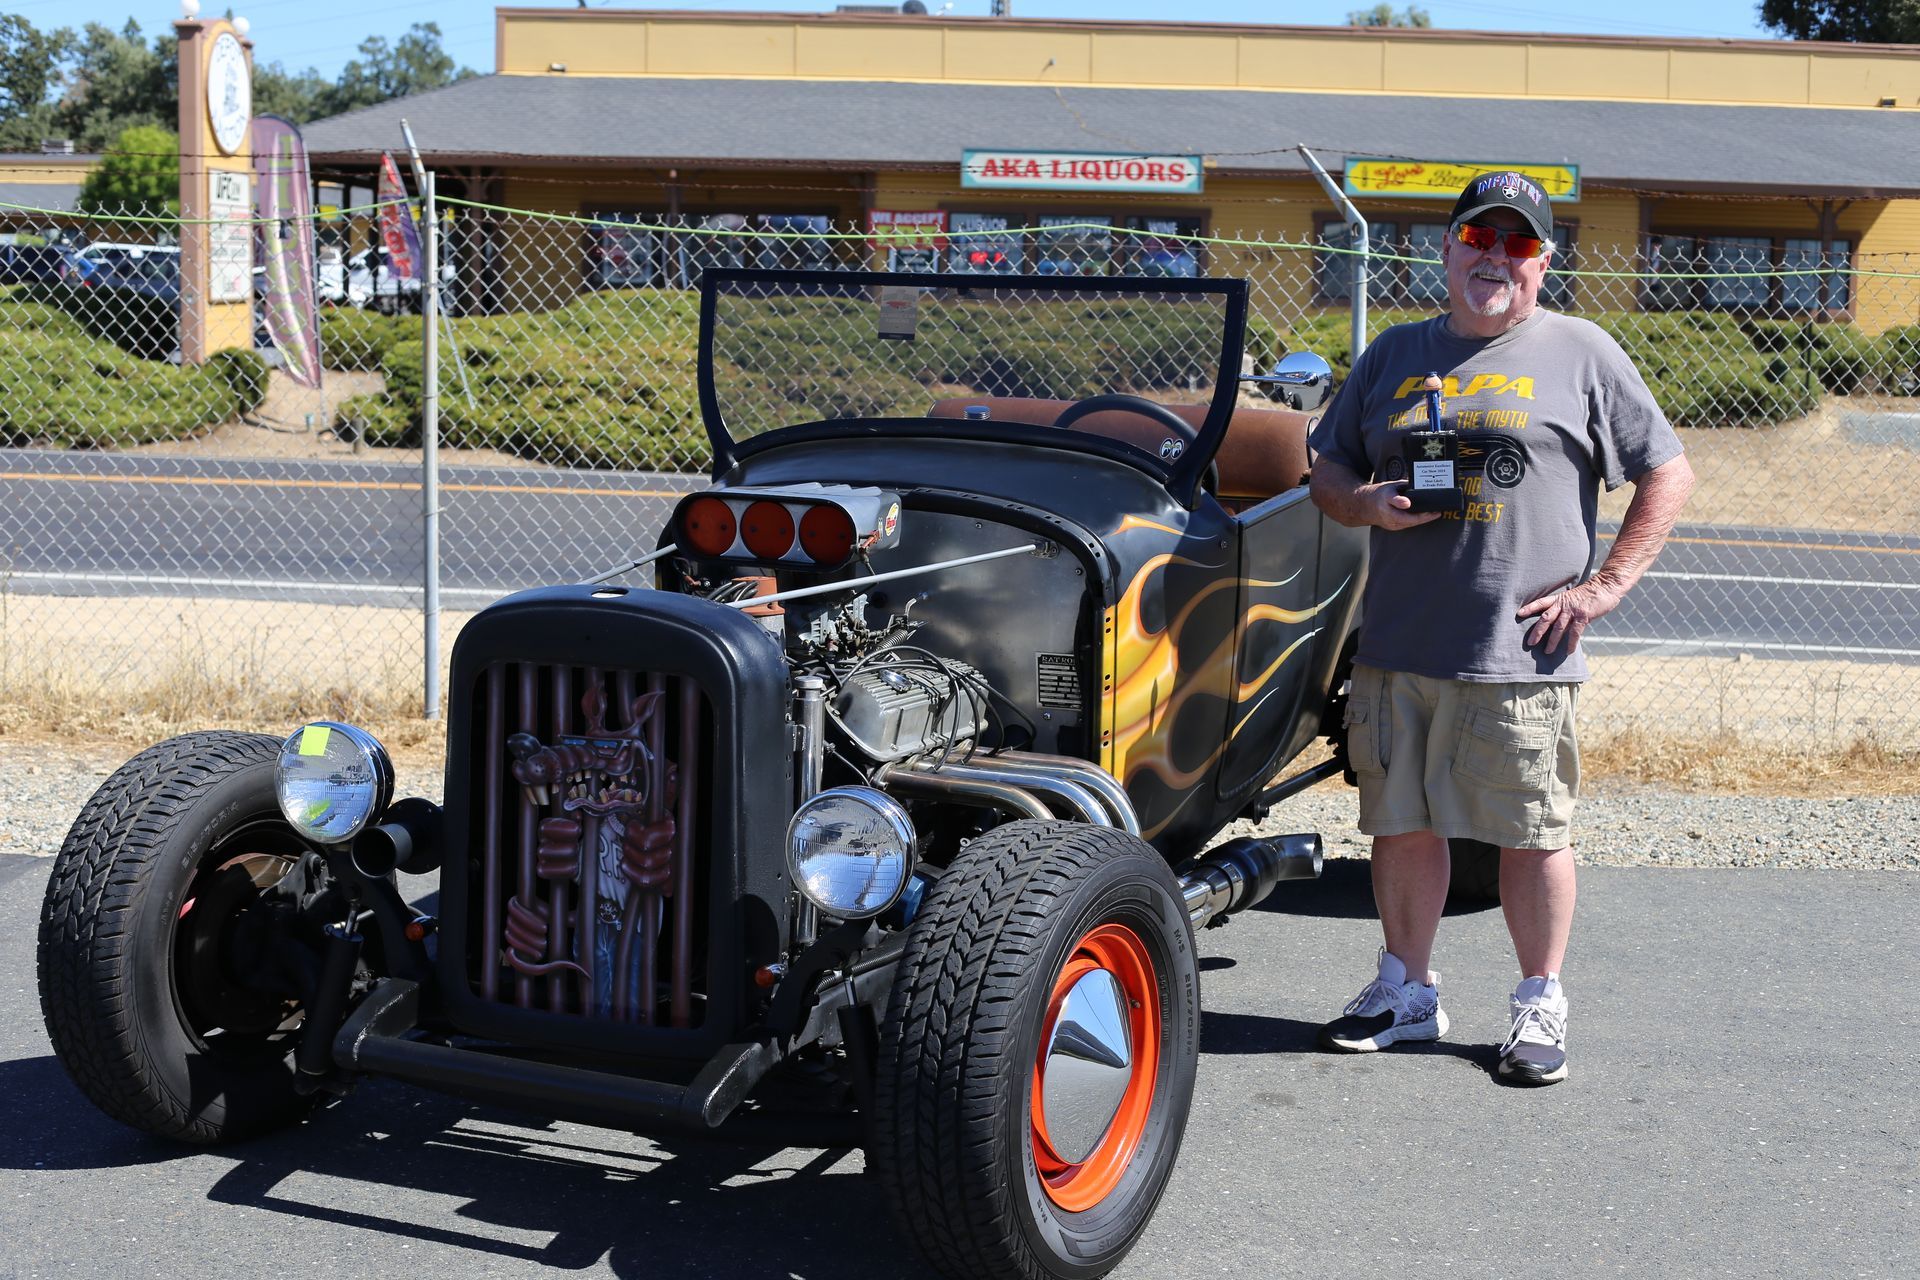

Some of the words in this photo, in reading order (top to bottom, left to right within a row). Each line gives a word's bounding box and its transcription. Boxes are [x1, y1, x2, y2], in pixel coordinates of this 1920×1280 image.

[981, 158, 1040, 179] AKA
[1049, 159, 1186, 183] LIQUORS
[1476, 174, 1543, 208] INFANTRY
[1392, 373, 1536, 400] PAPA
[1387, 410, 1411, 432] THE
[1413, 402, 1447, 423] MN
[1457, 409, 1482, 430] THE
[1485, 409, 1530, 430] MYTH
[1442, 507, 1461, 521] HE
[1465, 502, 1505, 525] BEST
[1398, 1004, 1438, 1025] dida
